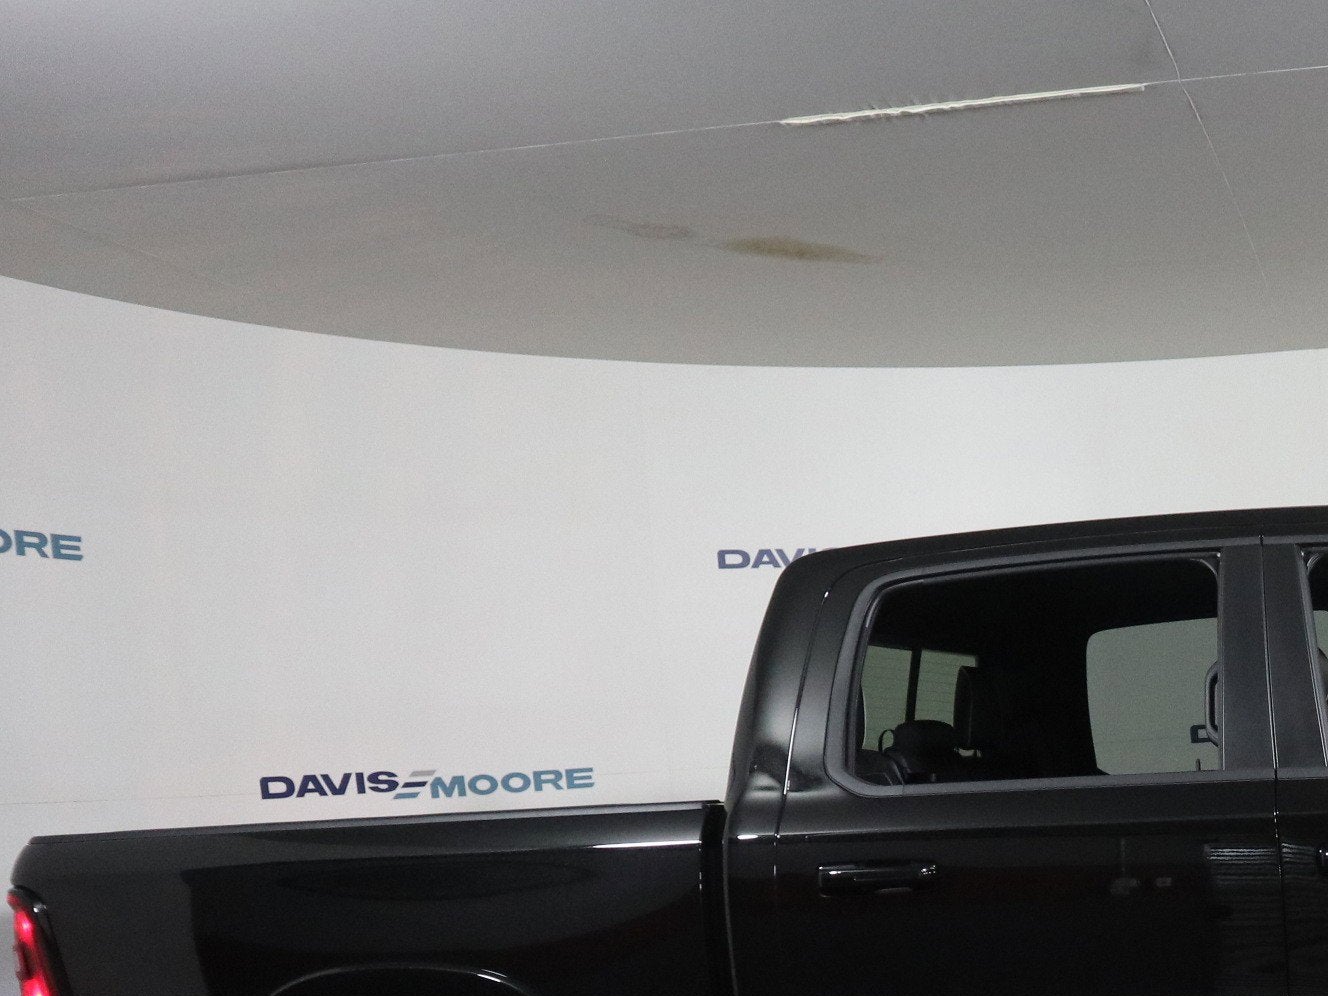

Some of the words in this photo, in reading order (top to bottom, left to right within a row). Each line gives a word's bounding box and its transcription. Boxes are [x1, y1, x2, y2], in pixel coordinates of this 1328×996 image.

[717, 548, 817, 569] DAV
[259, 770, 399, 800] DAVIS
[430, 767, 595, 798] MOORE
